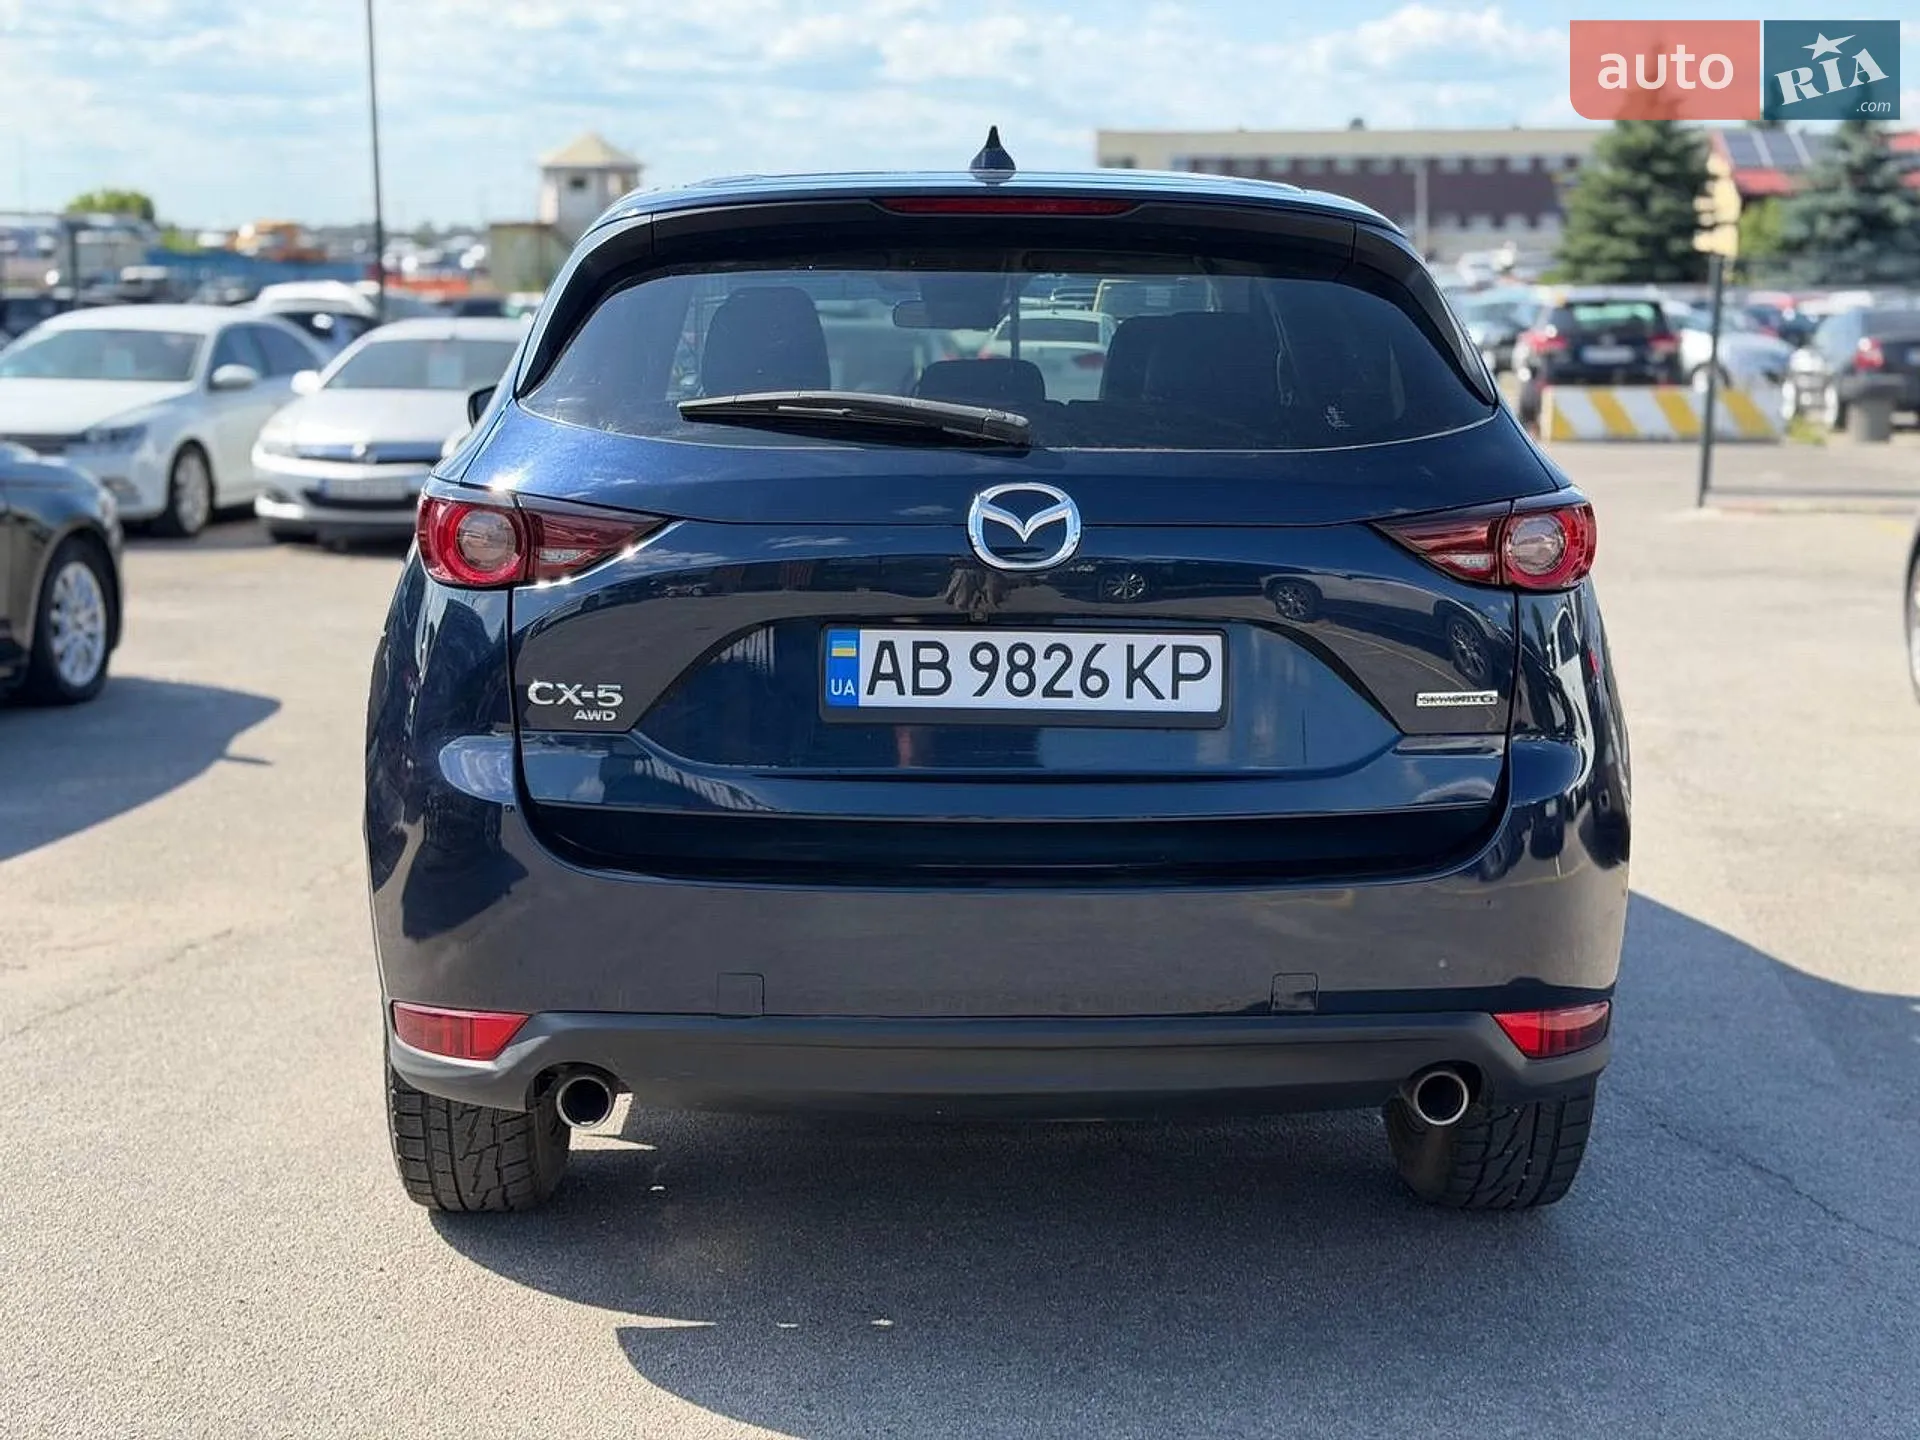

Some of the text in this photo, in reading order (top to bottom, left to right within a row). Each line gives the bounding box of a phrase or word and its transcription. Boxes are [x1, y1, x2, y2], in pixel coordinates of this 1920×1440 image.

[867, 641, 1212, 700] AB 9826 KP
[528, 681, 623, 707] CX-5
[830, 679, 856, 696] UA
[573, 709, 616, 721] AWD
